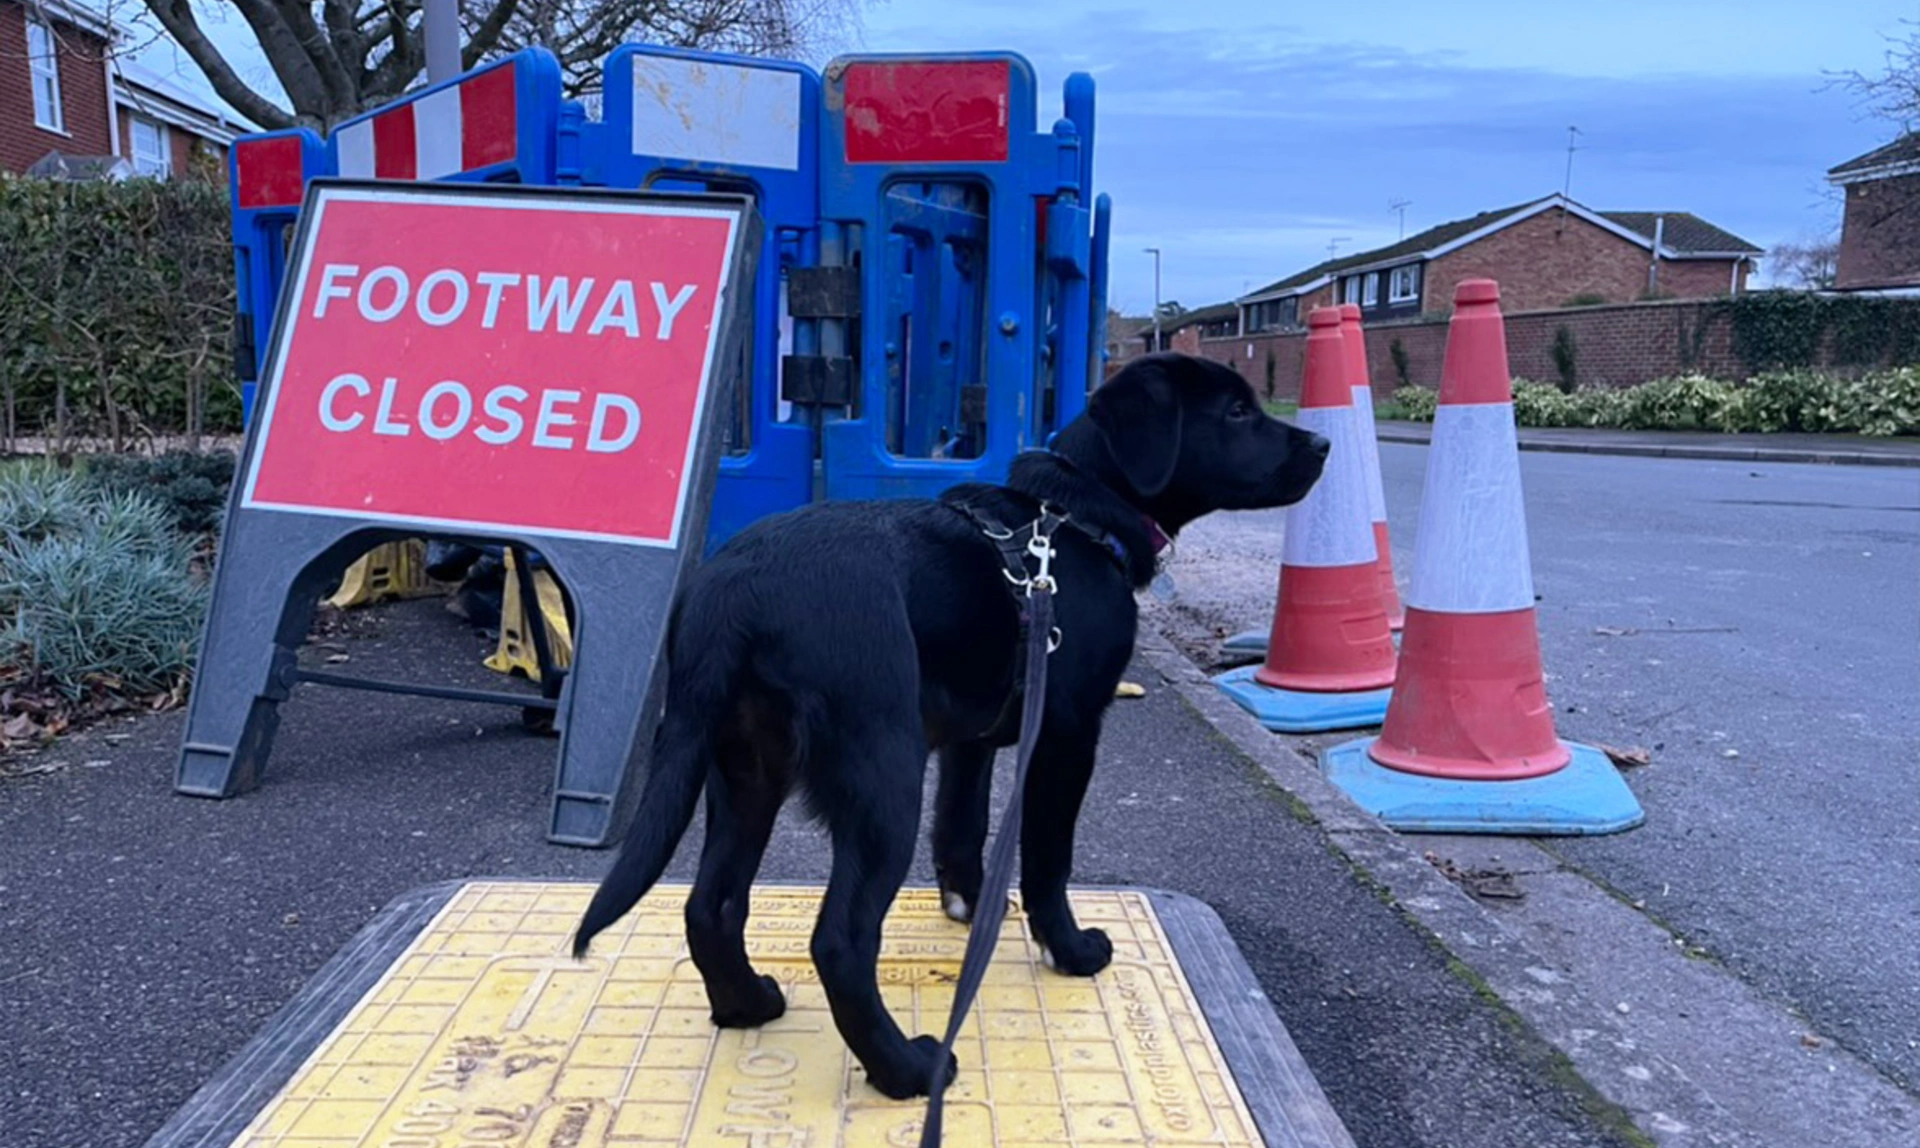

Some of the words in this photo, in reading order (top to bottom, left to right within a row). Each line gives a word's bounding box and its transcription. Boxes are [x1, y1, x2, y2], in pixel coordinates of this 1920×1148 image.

[313, 264, 697, 340] FOOTWAY
[318, 373, 642, 453] CLOSED
[1112, 969, 1192, 1132] oxfordplastics.com
